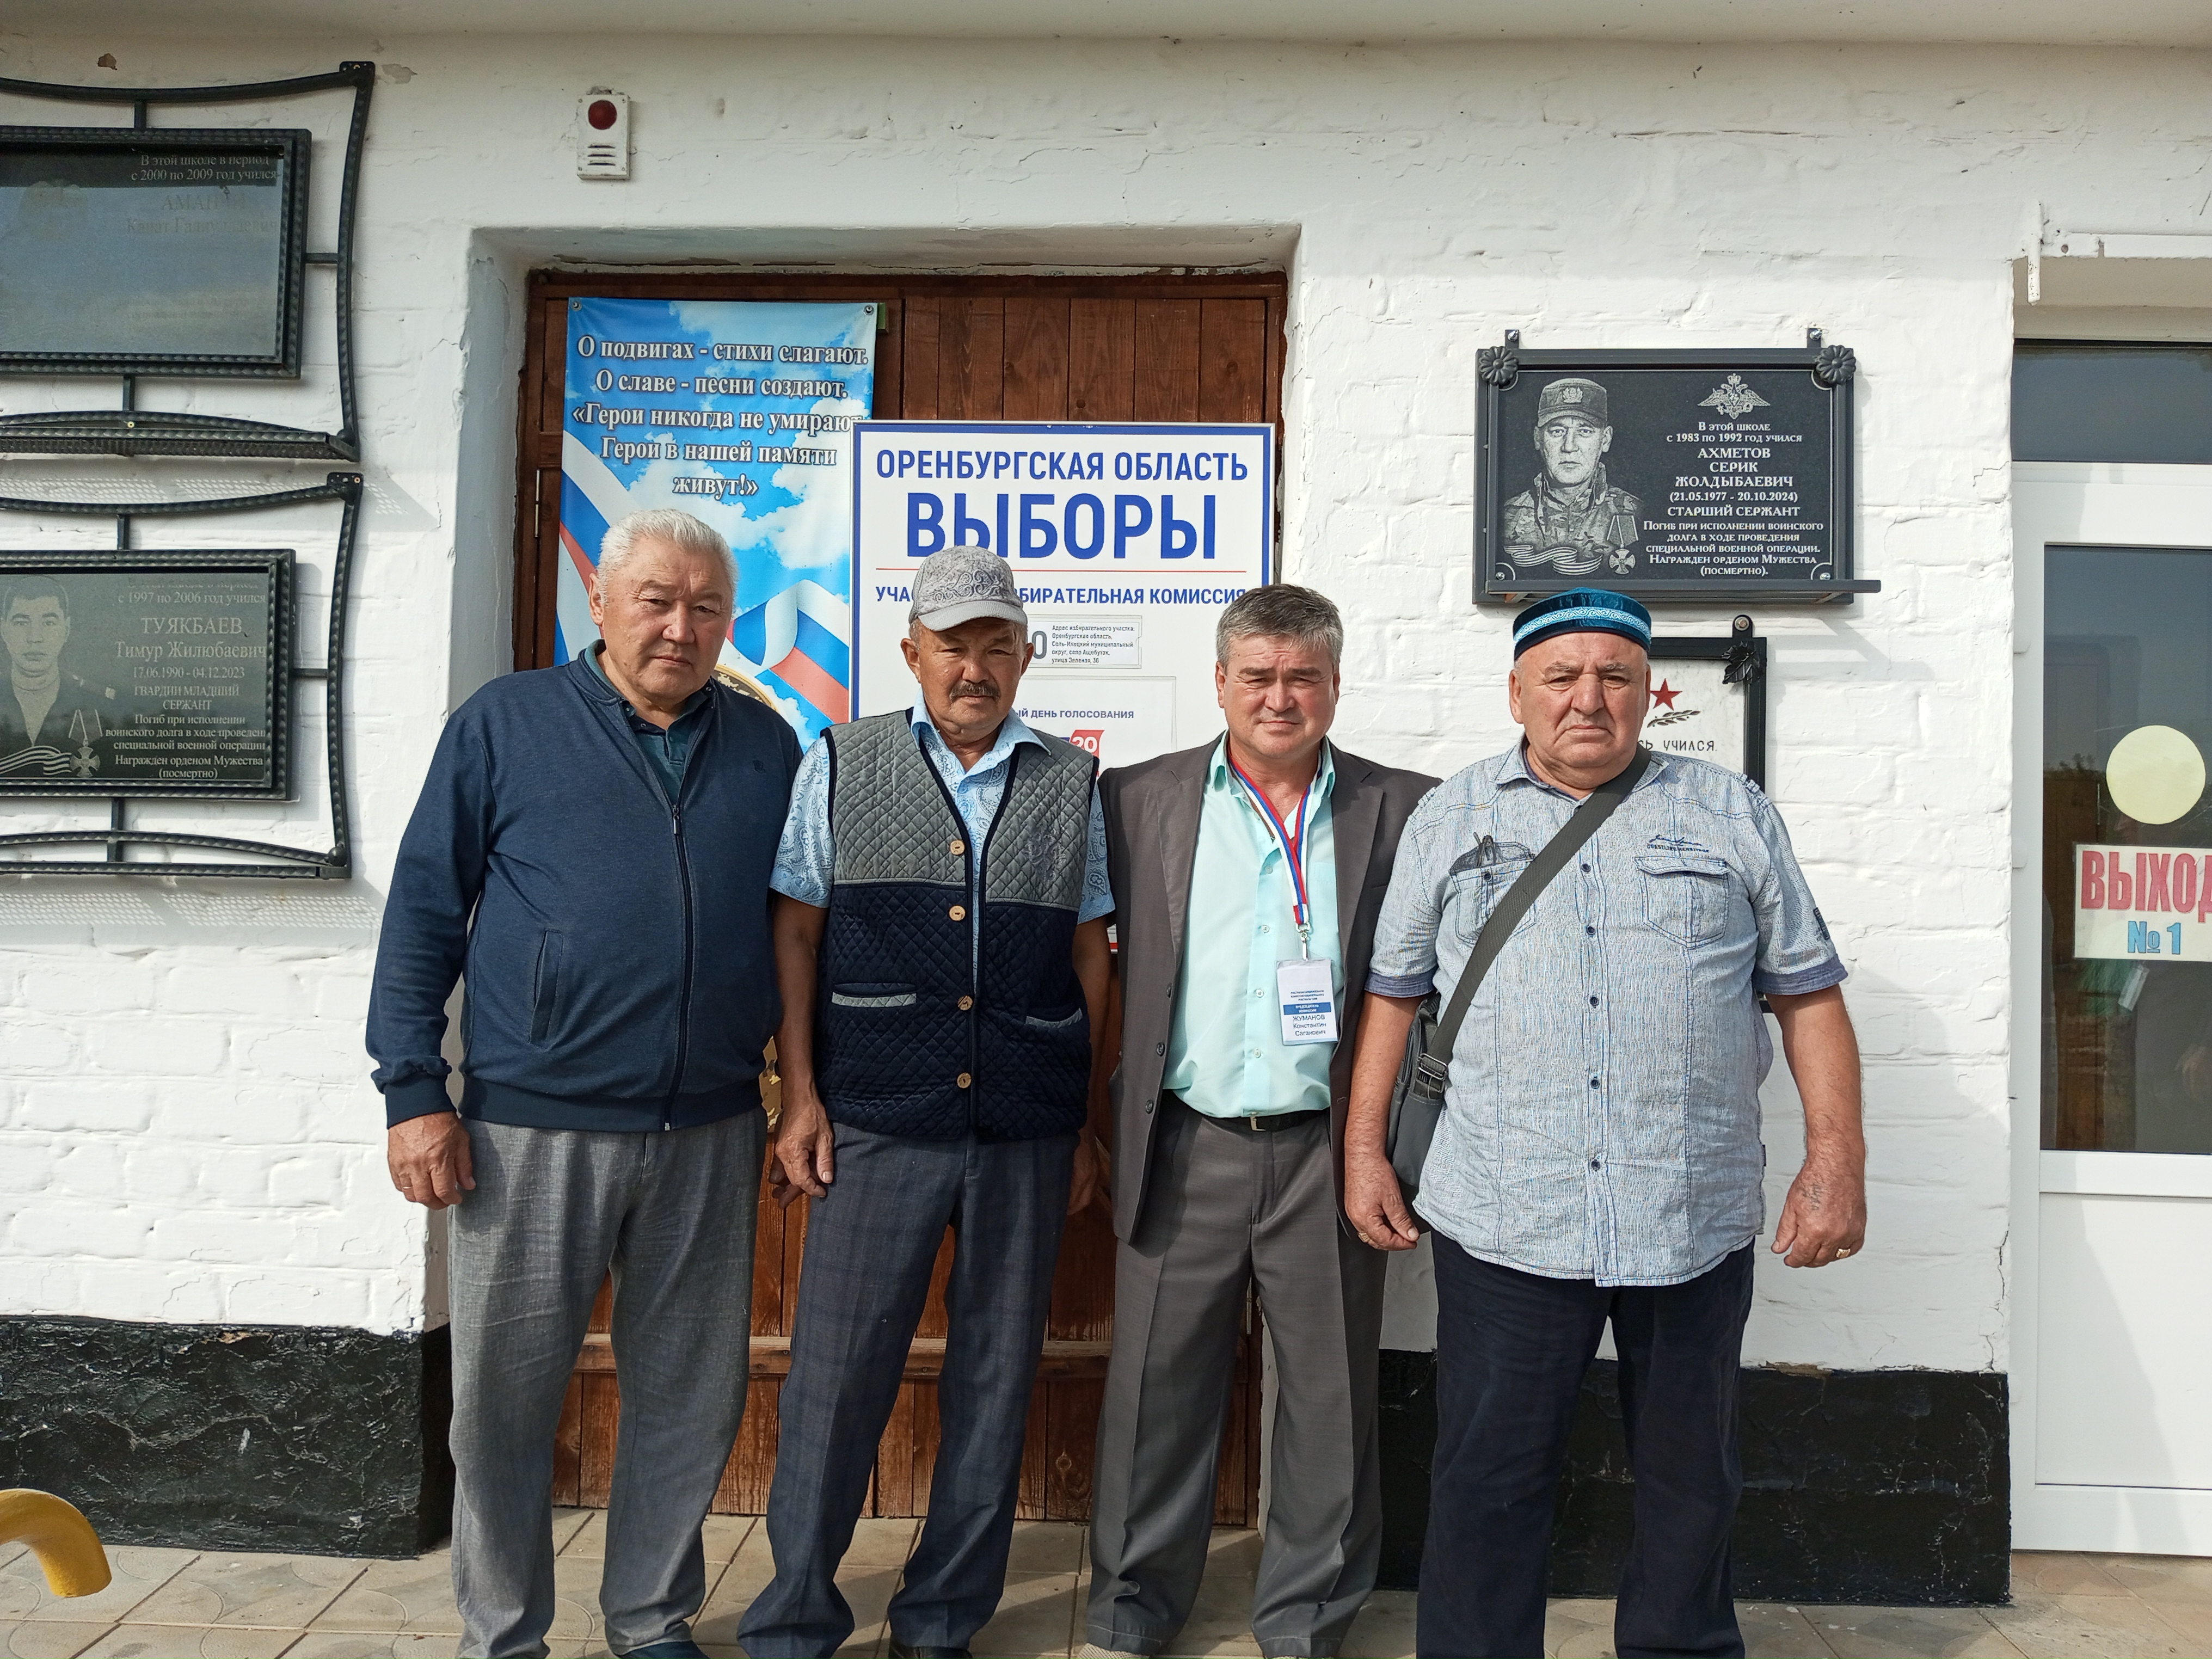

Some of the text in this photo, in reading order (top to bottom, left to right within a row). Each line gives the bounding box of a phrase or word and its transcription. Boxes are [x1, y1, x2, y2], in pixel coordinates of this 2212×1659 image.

[141, 155, 269, 168] В этой школе в период
[131, 168, 277, 182] с 2000 по 2009 год учился
[577, 335, 595, 358] О
[601, 341, 695, 360] подвигах
[713, 345, 773, 362] стихи
[779, 346, 869, 365] слагают.
[595, 369, 612, 391] О
[618, 375, 676, 393] славе
[695, 377, 755, 395] песни
[761, 380, 848, 399] создают.
[572, 402, 863, 437] «Герои никогда не умираю
[1676, 433, 1700, 443] 1983
[1718, 433, 1742, 443] 1992
[601, 436, 837, 466] Герои в нашей памяти
[1697, 447, 1771, 459] АХМЕТОВ
[876, 450, 1248, 481] ОРЕНБУРГСКАЯ ОБЛАСТЬ
[1709, 462, 1758, 472] СЕРИК
[673, 473, 759, 500] живут!»
[1675, 476, 1794, 489] ЖОЛДЫБАЕВИЧ
[1669, 491, 1726, 502] (21.05.1977
[1737, 491, 1798, 502] 20.10.2024)
[1667, 504, 1801, 517] СТАРШИЙ СЕРЖАНТ
[907, 492, 1216, 560] ВЫБОРЫ
[128, 592, 155, 604] 1997
[157, 594, 171, 604] по
[174, 591, 201, 603] 2006
[204, 594, 223, 604] год
[225, 593, 266, 606] учился
[1015, 588, 1143, 604] БИРАТЕЛЬНАЯ
[140, 617, 243, 635] ТУЯКБАЕВ
[1069, 625, 1111, 633] избирательного
[115, 641, 267, 662] Тимур Жилюбаевич
[133, 666, 184, 679] 17.06.1990
[193, 666, 245, 679] 04.12.2023
[134, 684, 239, 697] ГВАРДИИ МЛАДШИЙ
[162, 700, 212, 710] СЕРЖАНТ
[135, 714, 245, 726] Погиб при исполнении
[1031, 710, 1058, 718] ДЕНЬ
[1060, 710, 1134, 718] ГОЛОСОВАНИЯ
[105, 729, 155, 738] воинского
[156, 729, 183, 738] долга
[194, 729, 216, 738] ходе
[113, 740, 175, 750] специальной
[177, 740, 217, 749] военной
[1072, 736, 1097, 753] 20
[115, 755, 264, 767] Награжден орденом Мужества
[158, 767, 218, 779] (посмертно)
